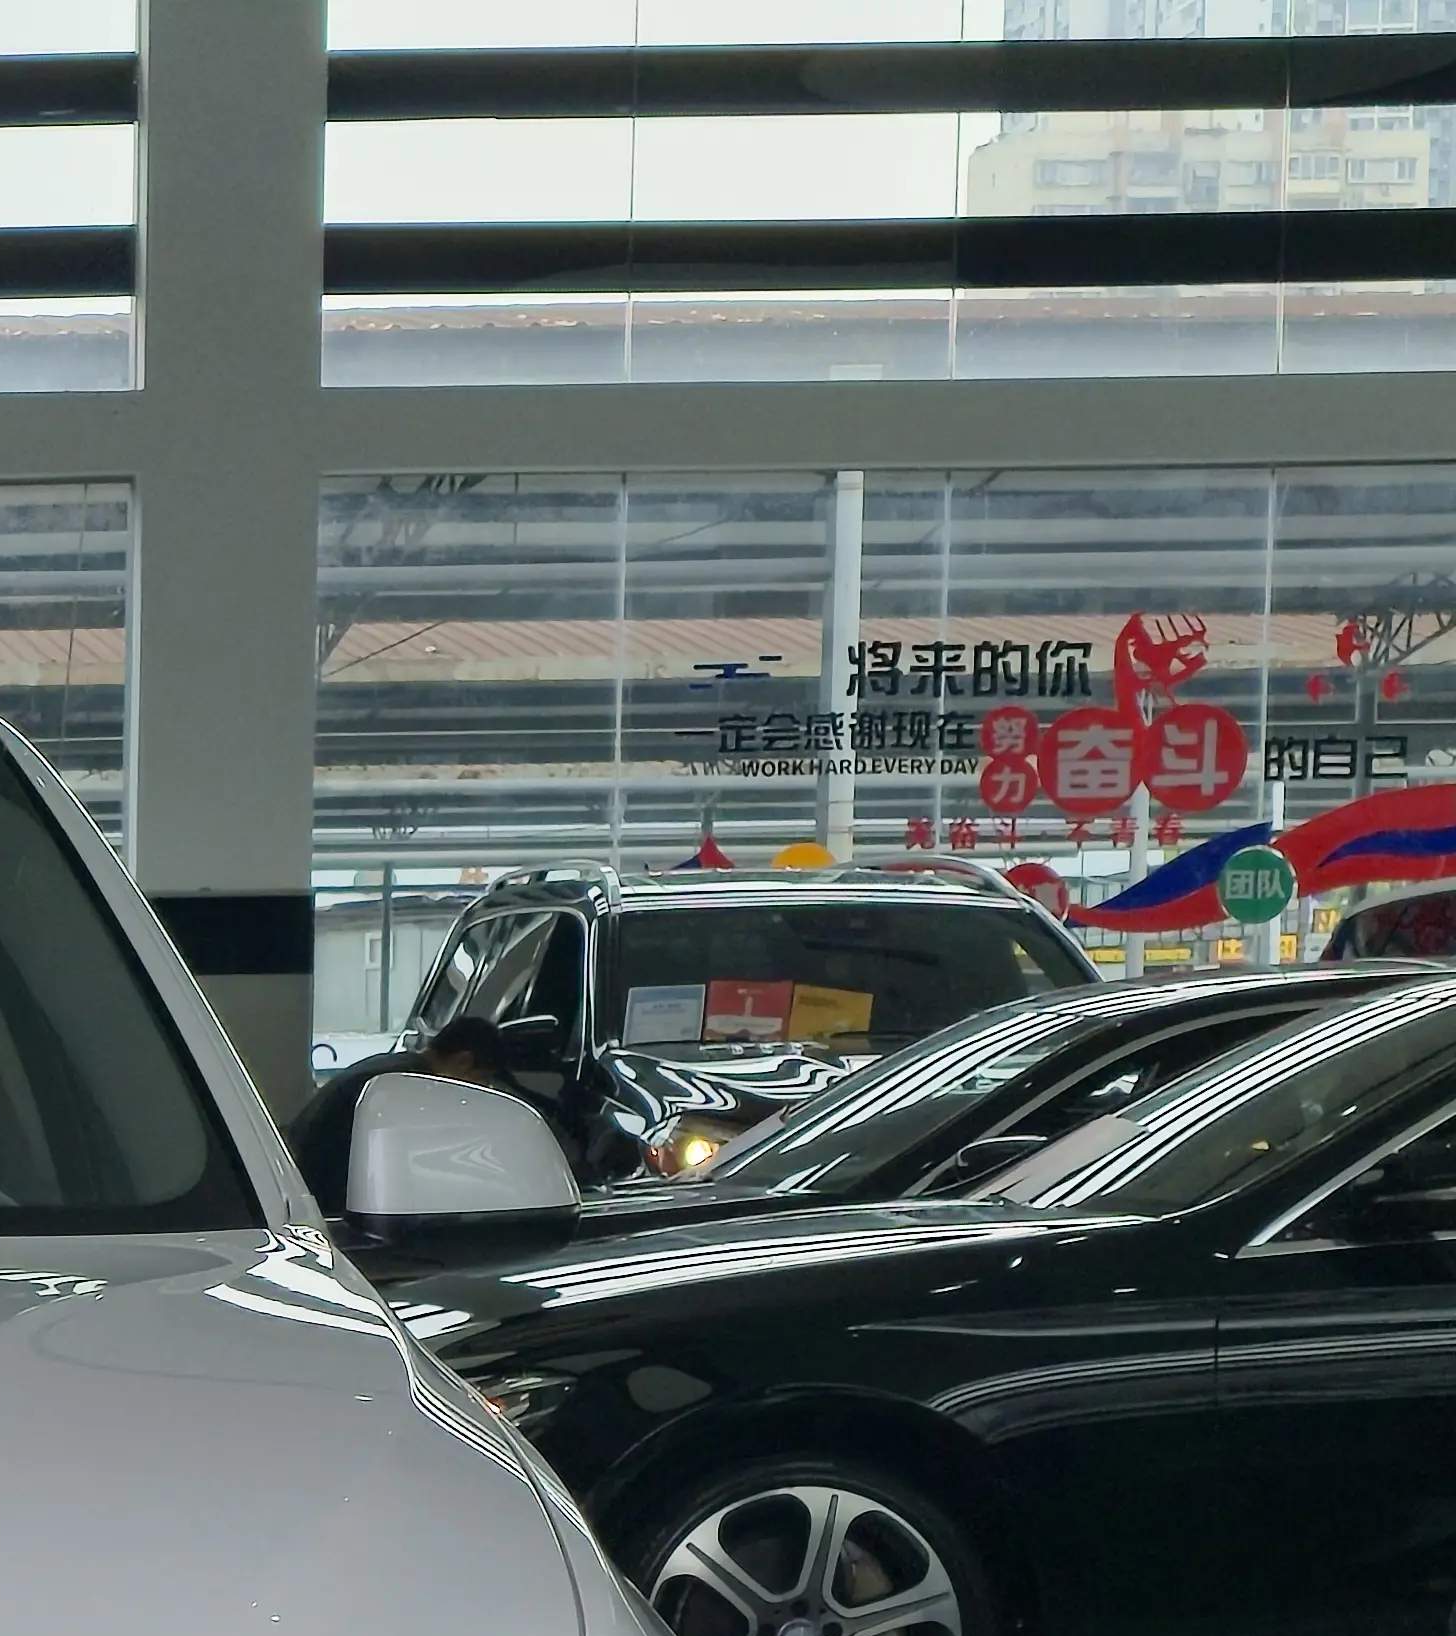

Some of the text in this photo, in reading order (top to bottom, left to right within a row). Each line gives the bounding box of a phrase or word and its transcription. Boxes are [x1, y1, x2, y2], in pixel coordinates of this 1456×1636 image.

[847, 640, 1093, 698] 将来的你
[674, 709, 1408, 804] 一定会感谢现在 努力 奋斗 的自己
[741, 758, 805, 778] WORK
[808, 758, 867, 777] HARD
[871, 757, 936, 776] EVERY
[939, 757, 980, 776] DAY
[1224, 867, 1286, 901] 团队
